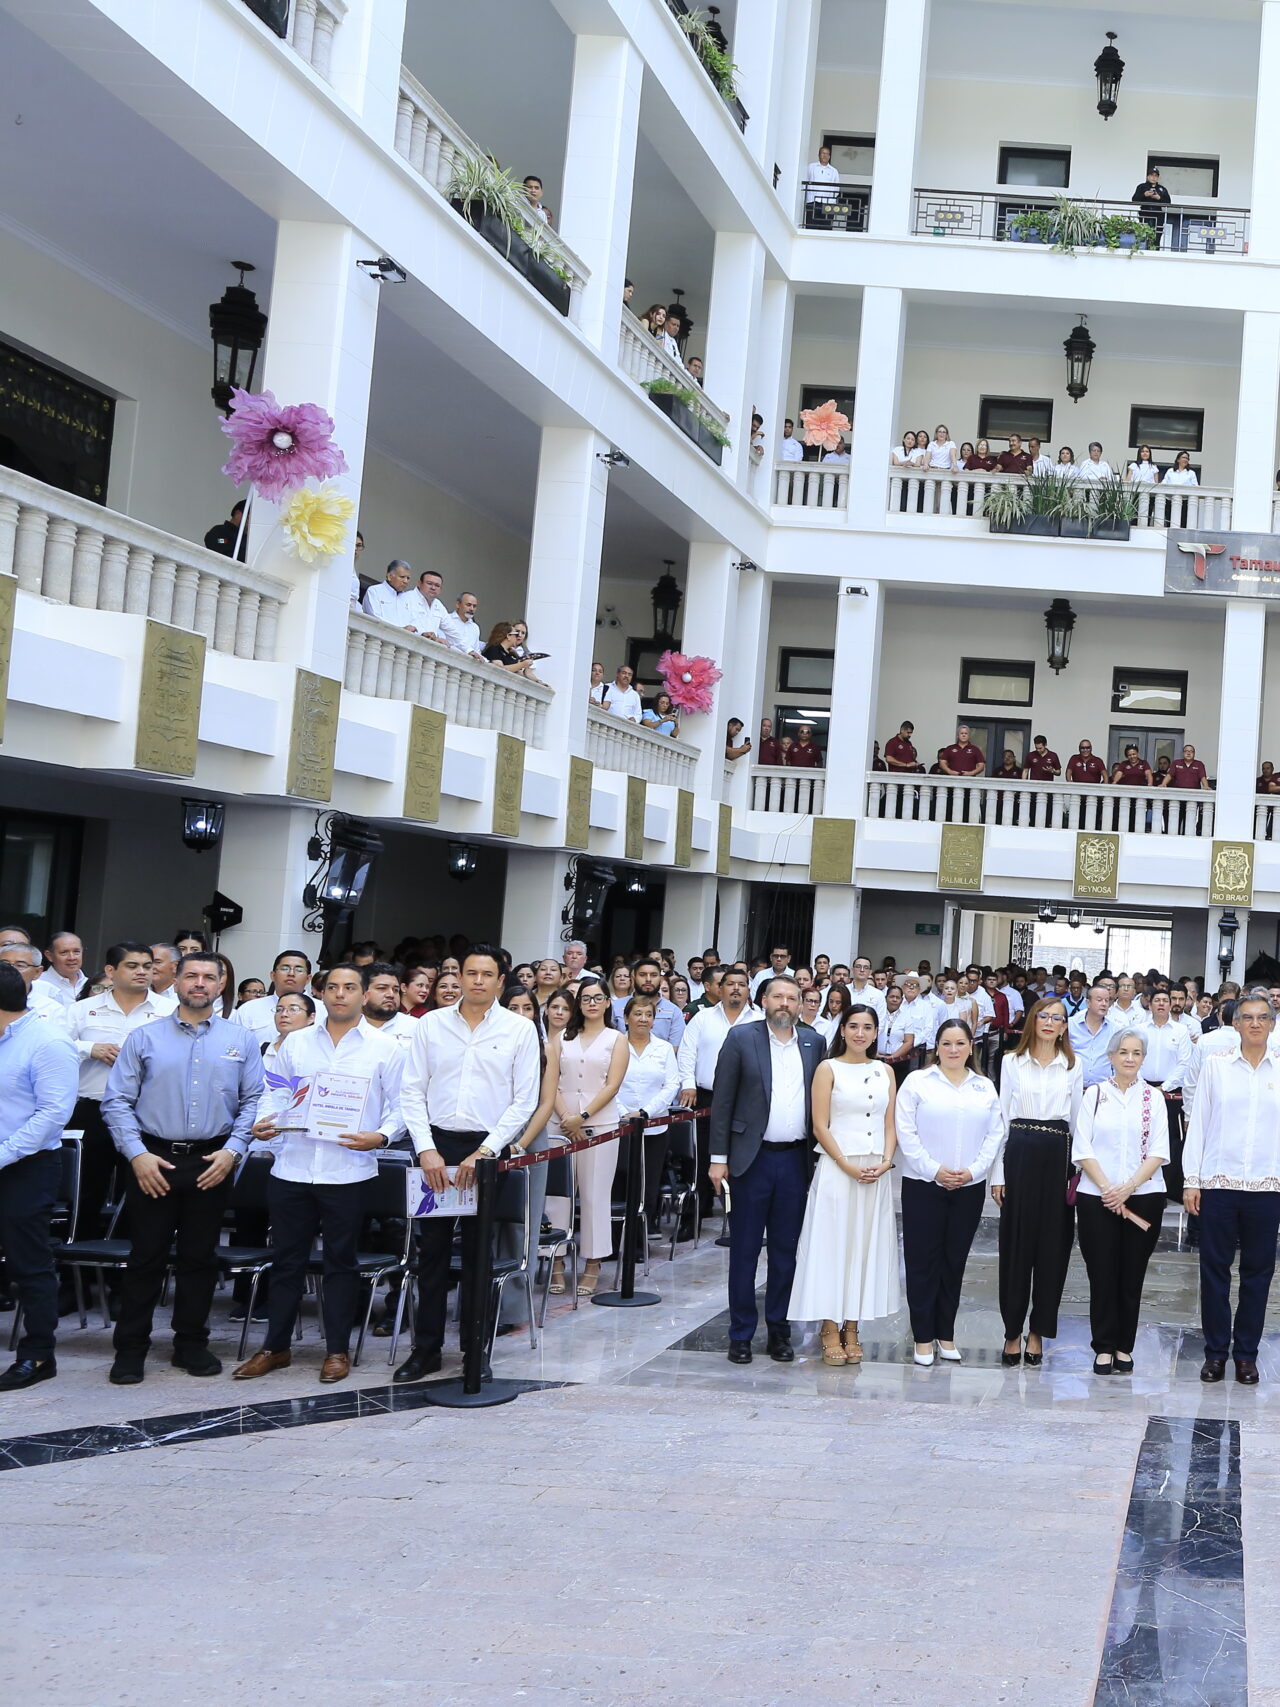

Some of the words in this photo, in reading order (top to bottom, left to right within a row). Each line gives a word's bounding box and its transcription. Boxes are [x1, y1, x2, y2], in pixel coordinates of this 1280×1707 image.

[1231, 574, 1260, 582] Gobierno
[940, 875, 979, 886] PALMILLAS
[1077, 885, 1112, 894] REYNOSA
[1211, 893, 1225, 902] RIO
[1225, 894, 1249, 903] BRAVO
